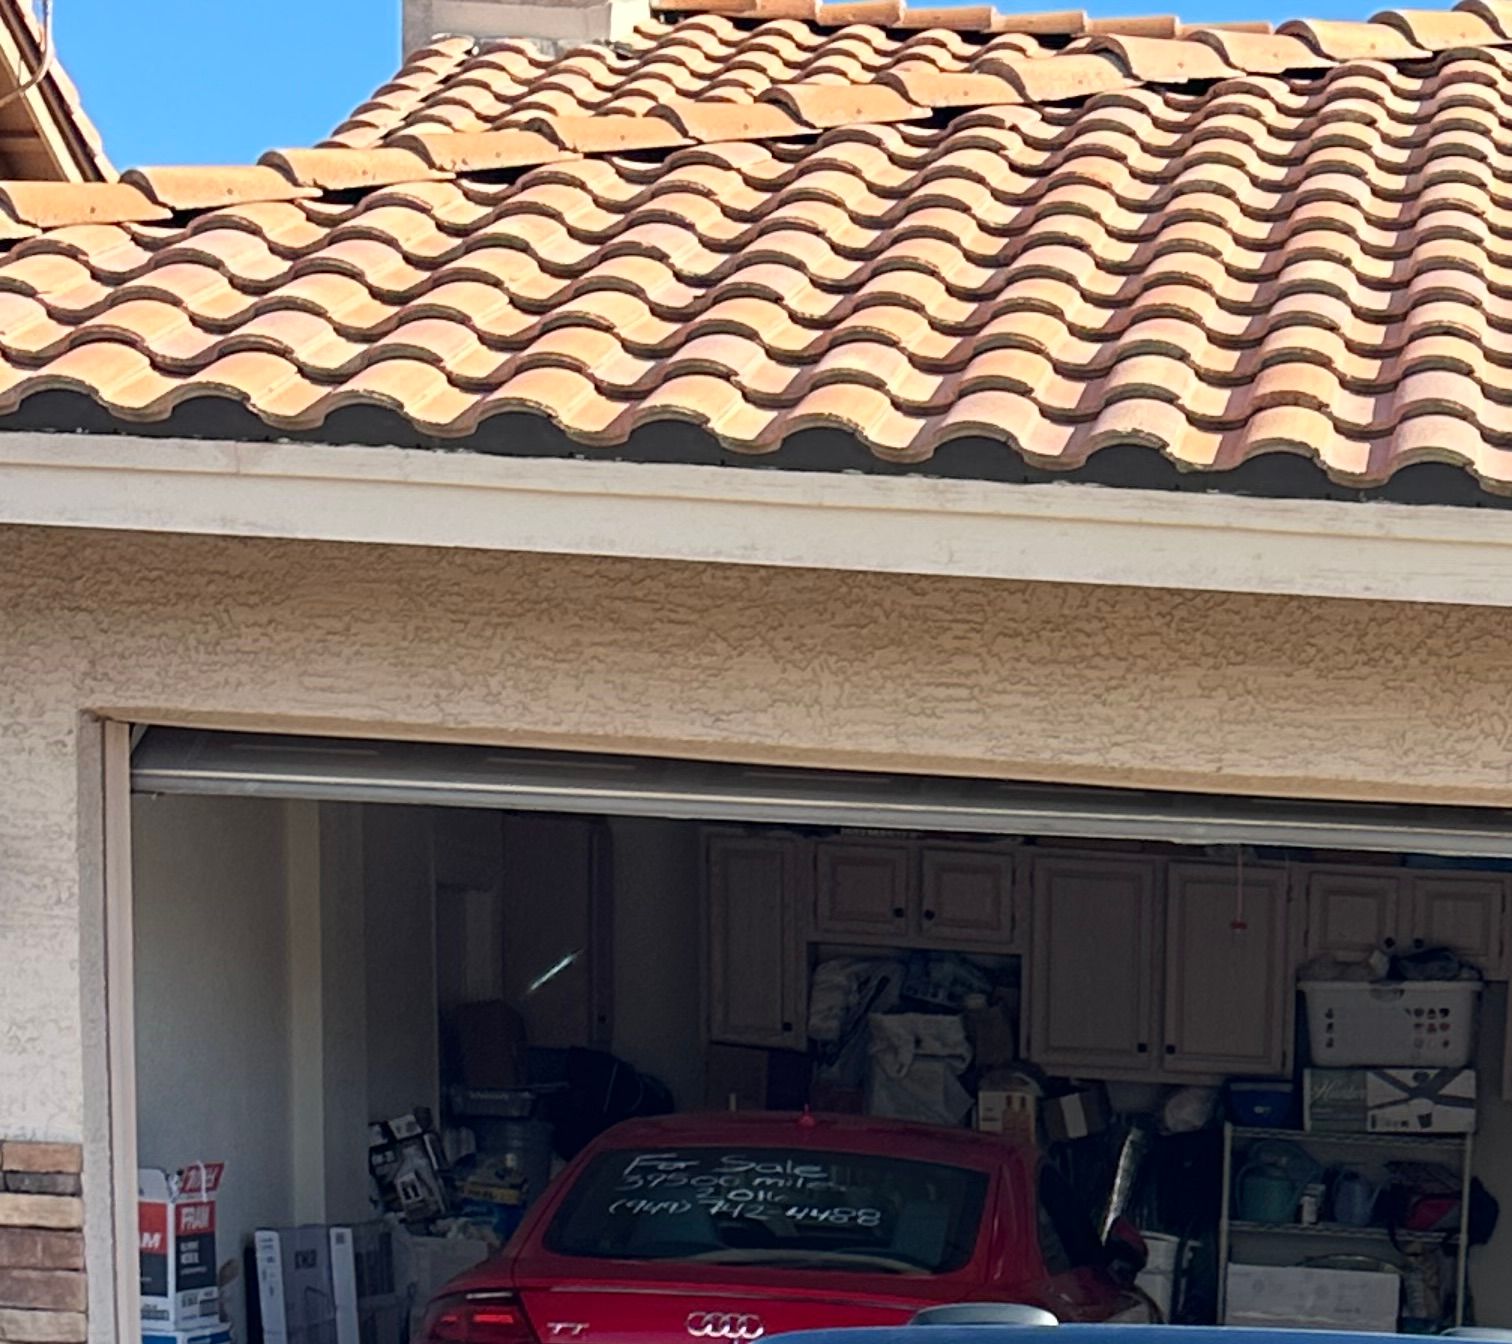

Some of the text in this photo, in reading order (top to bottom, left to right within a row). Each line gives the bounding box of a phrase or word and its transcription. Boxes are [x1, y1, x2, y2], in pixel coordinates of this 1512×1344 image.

[623, 1153, 828, 1178] For Sale
[546, 1322, 590, 1336] TT
